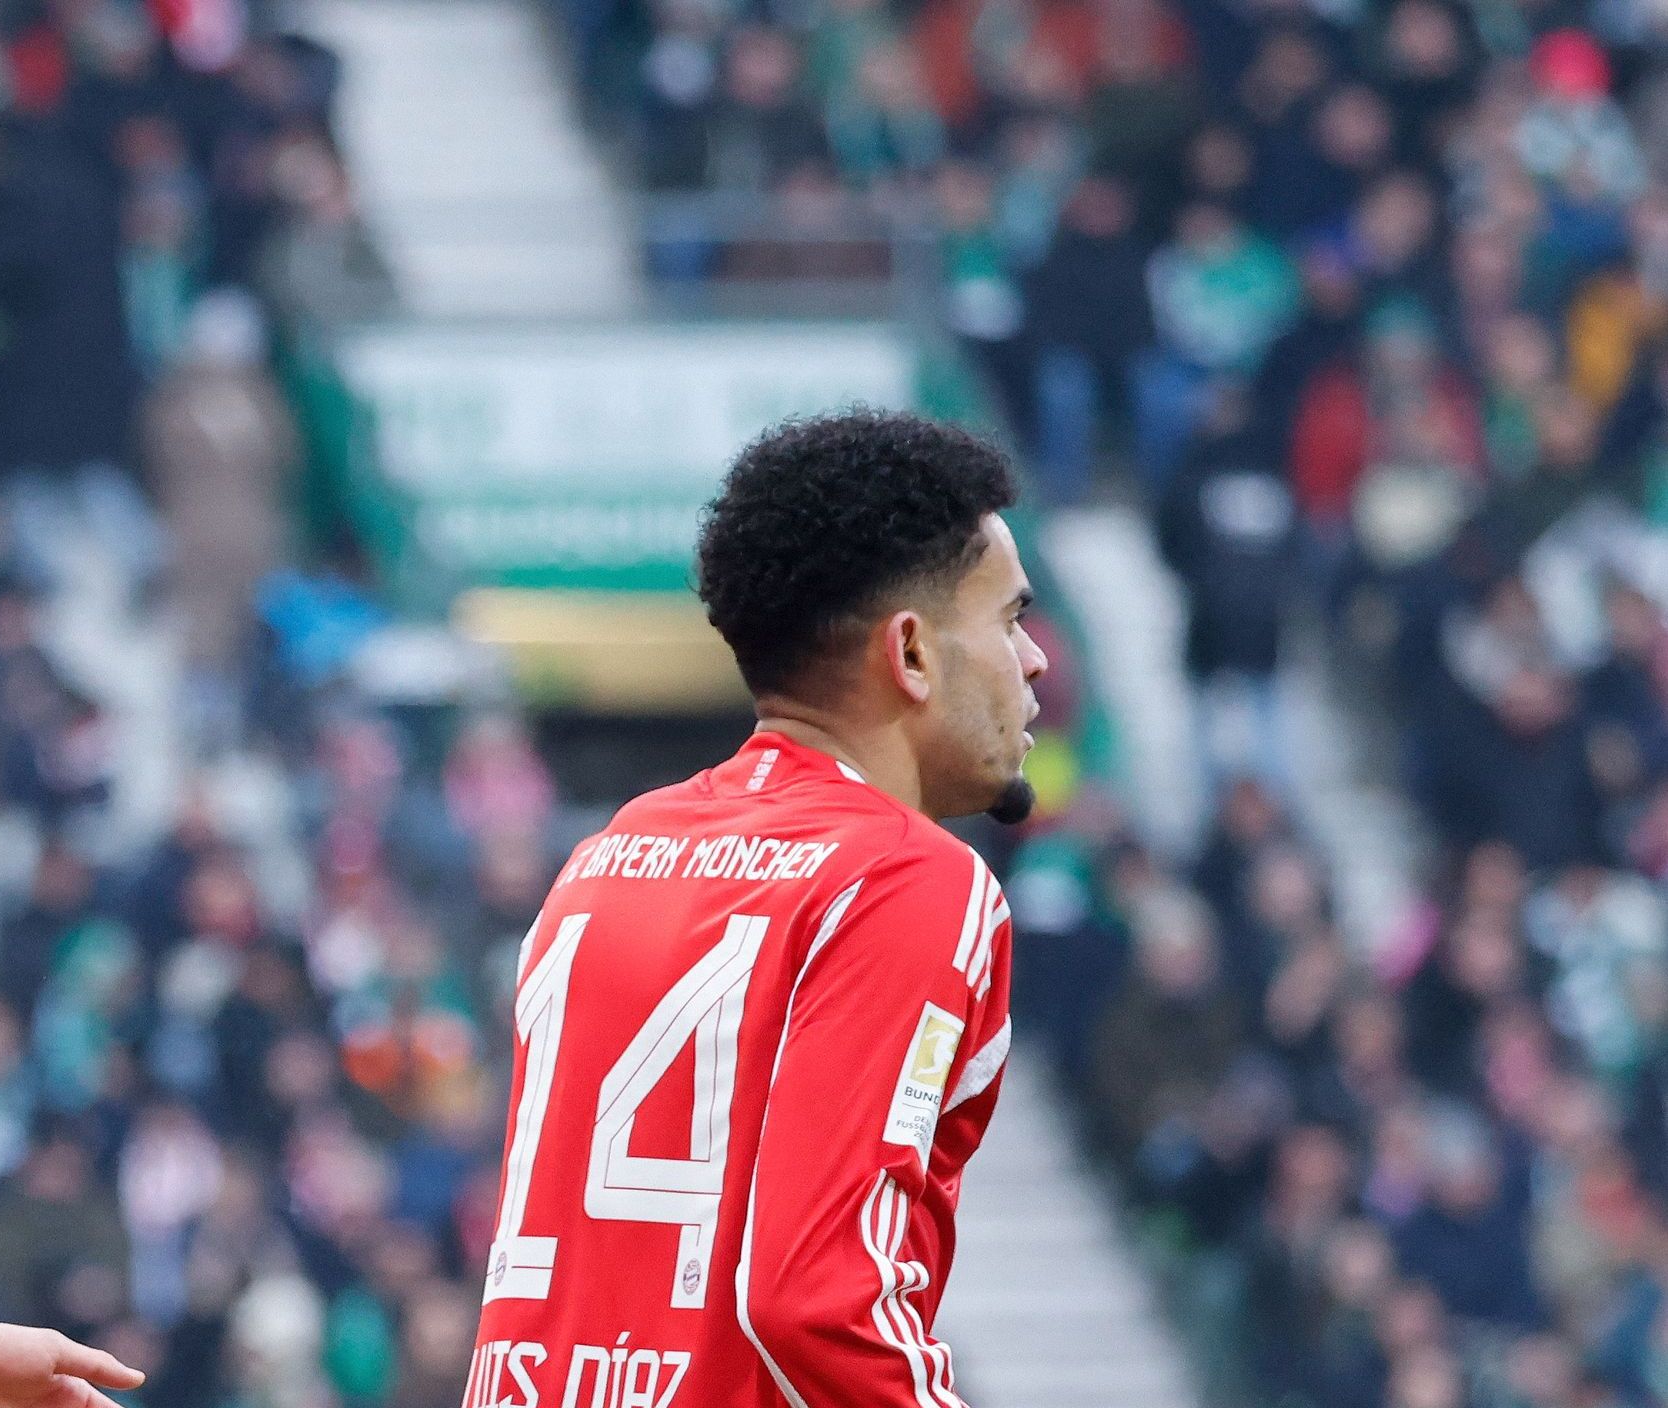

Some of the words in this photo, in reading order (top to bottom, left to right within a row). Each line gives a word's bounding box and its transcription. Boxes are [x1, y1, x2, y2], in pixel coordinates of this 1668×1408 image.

[579, 833, 691, 880] BAYERN
[681, 834, 840, 881] MÜNCHEN
[483, 913, 771, 1309] 14
